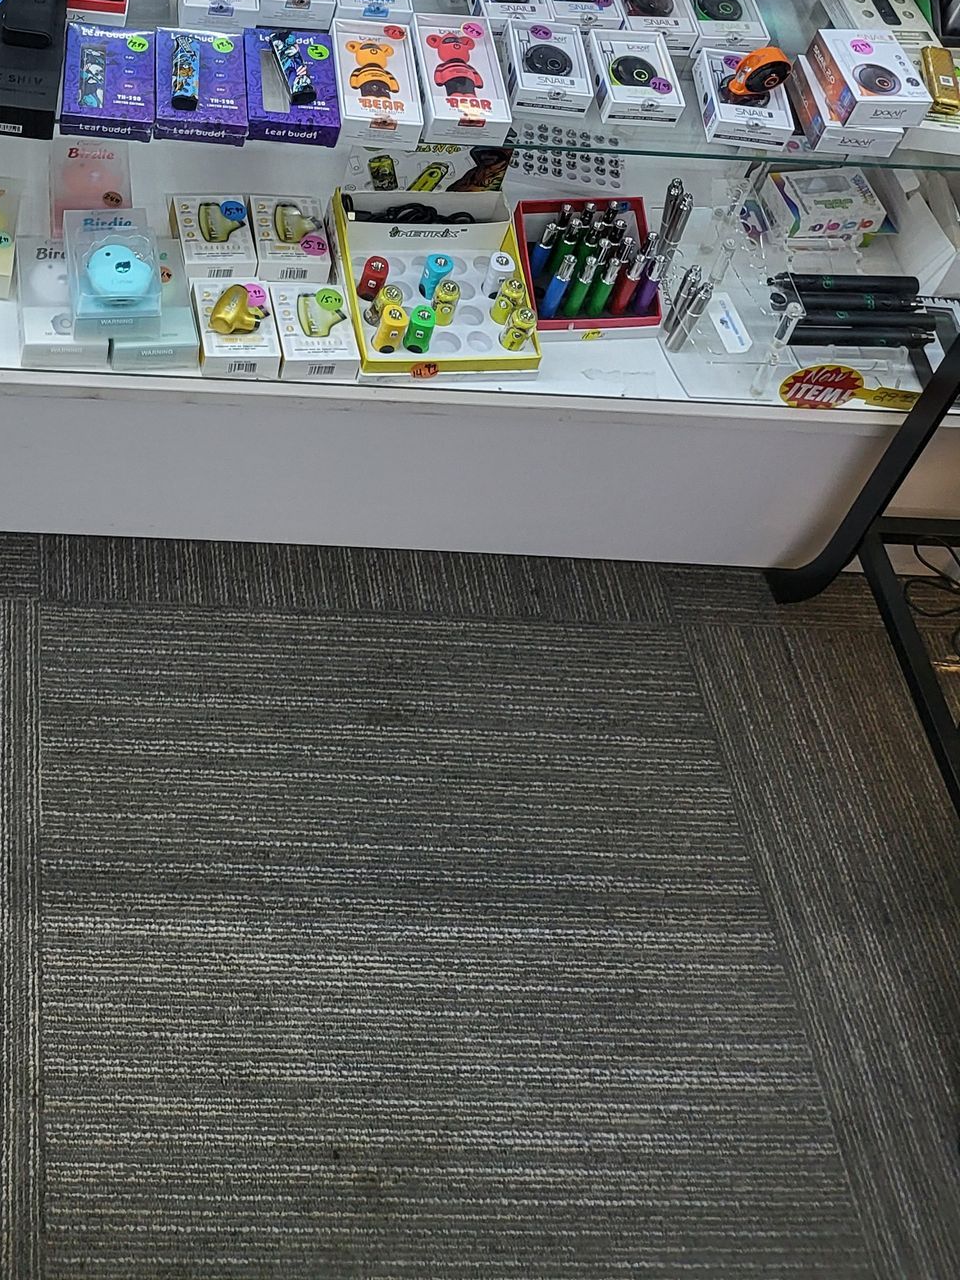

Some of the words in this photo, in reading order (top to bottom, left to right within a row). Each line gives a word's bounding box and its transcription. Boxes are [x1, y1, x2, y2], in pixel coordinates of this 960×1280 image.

[735, 108, 768, 118] SNAIL
[265, 128, 286, 137] Leaf
[141, 348, 174, 357] WARNING
[787, 383, 850, 404] ITEM!
